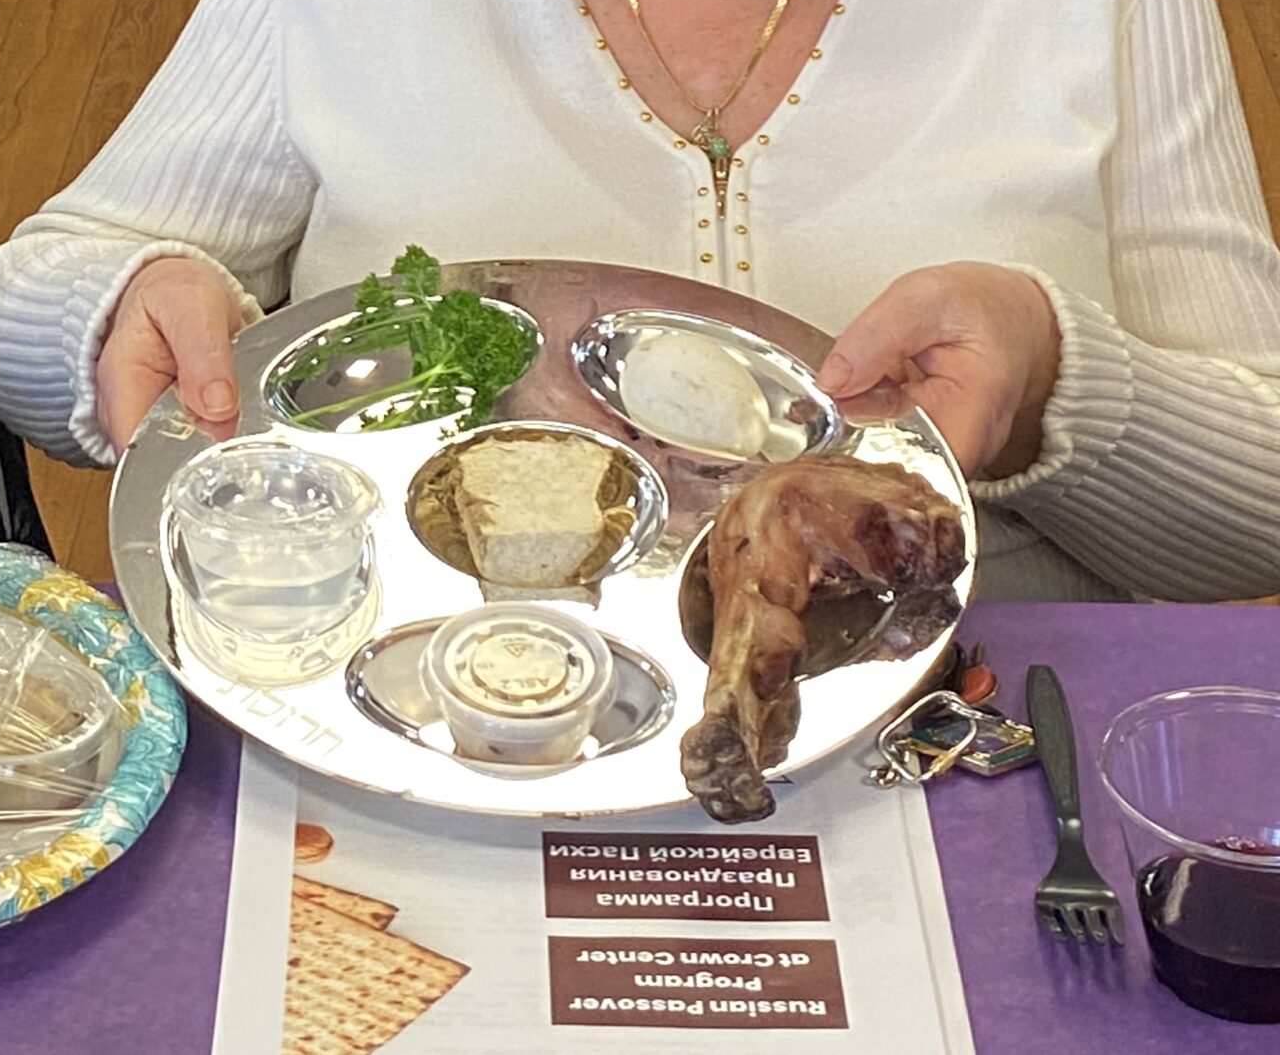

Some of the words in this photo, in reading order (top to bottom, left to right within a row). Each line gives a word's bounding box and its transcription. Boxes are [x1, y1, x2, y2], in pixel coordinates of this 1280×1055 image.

[549, 844, 641, 861] Пасхи
[649, 844, 812, 863] Еврейской
[570, 867, 795, 887] Празднования
[596, 891, 774, 911] Программа
[576, 949, 674, 965] Center
[680, 951, 775, 966] Crown
[779, 953, 810, 966] at
[634, 972, 762, 992] Program
[569, 997, 705, 1015] Passover
[709, 1000, 827, 1018] Russian
